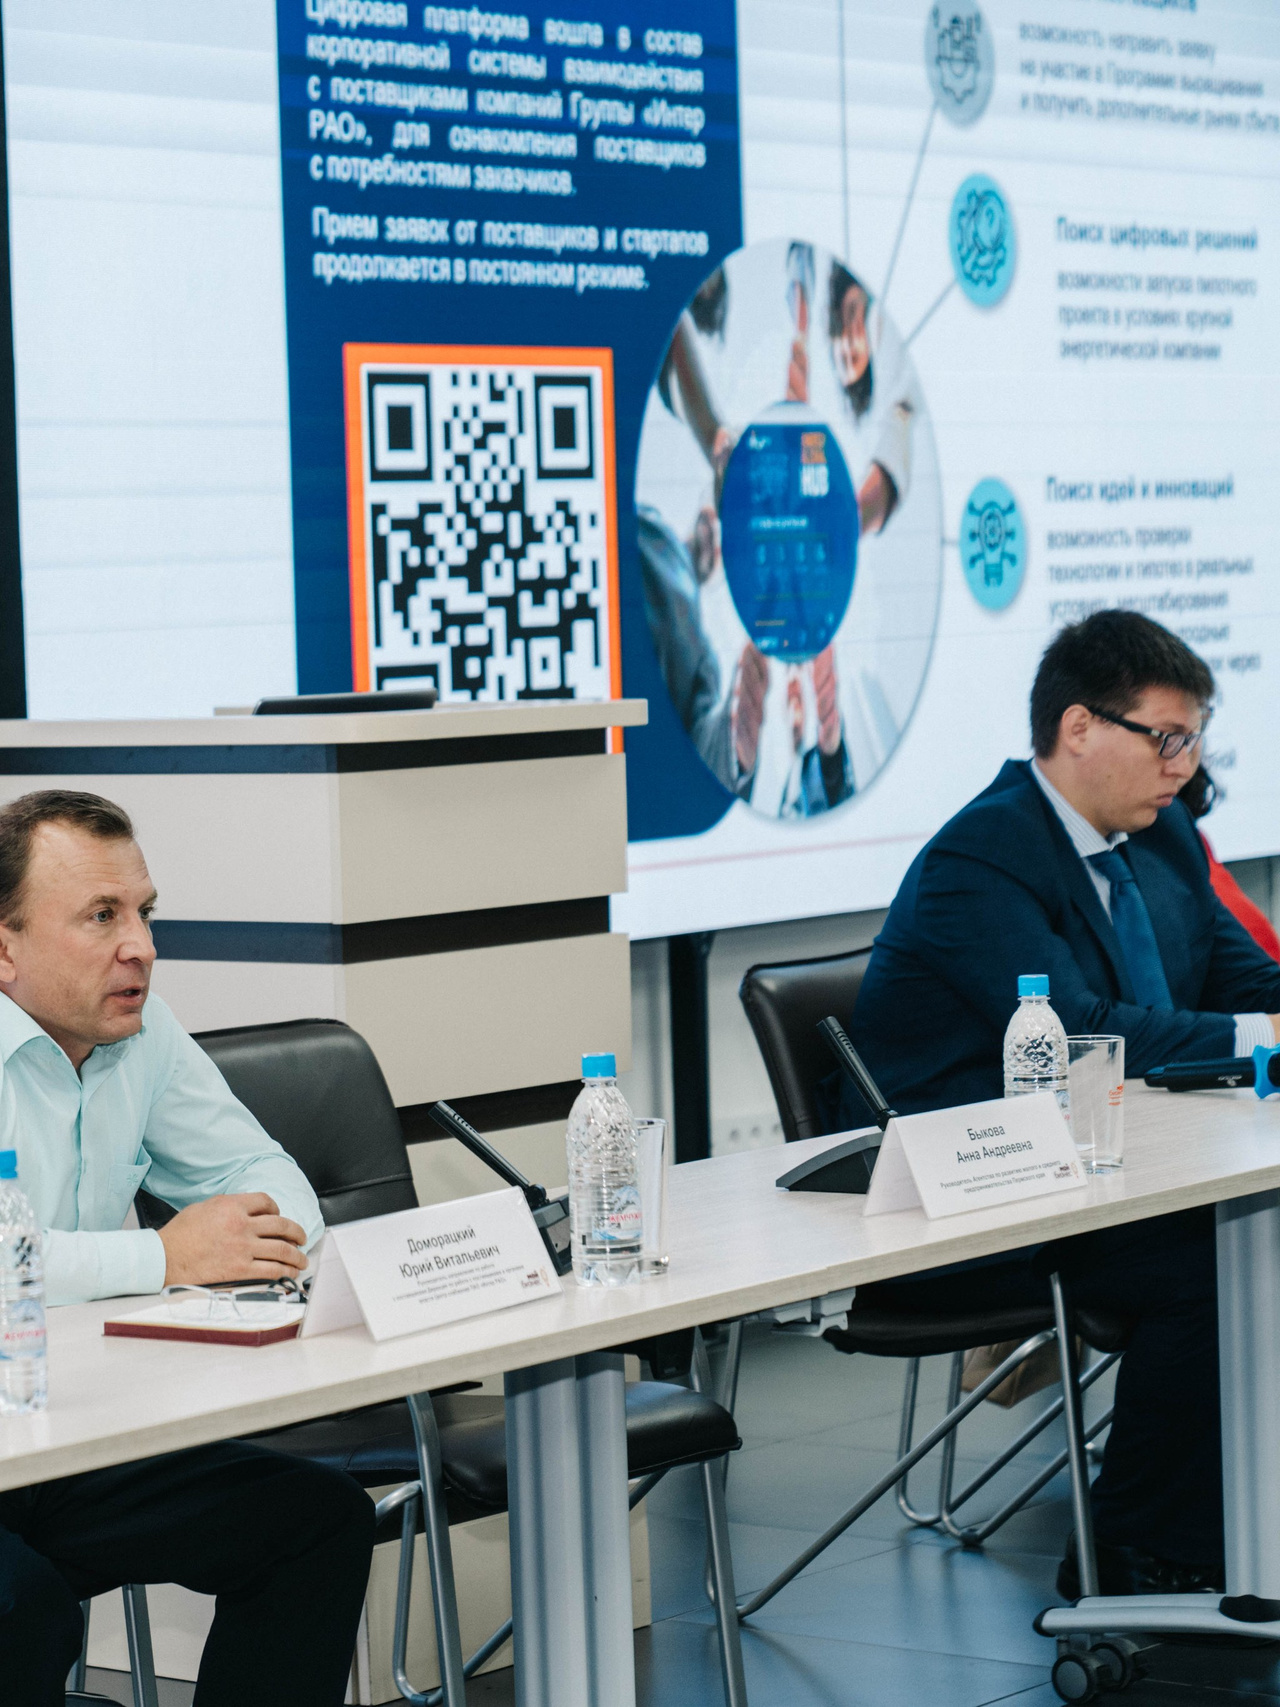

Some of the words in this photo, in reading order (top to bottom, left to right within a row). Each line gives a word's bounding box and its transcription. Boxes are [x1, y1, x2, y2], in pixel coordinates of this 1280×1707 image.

[305, 0, 408, 30] Цифровая
[424, 6, 529, 43] платформа
[544, 19, 604, 48] вошла
[617, 26, 631, 51] в
[644, 29, 703, 57] состав
[306, 34, 450, 71] корпоративной
[468, 51, 547, 80] системы
[564, 58, 704, 93] взаимодействия
[307, 75, 321, 101] с
[331, 76, 468, 115] поставщиками
[476, 89, 563, 119] компаний
[569, 92, 635, 130] Группы
[643, 99, 705, 136] «Интер
[309, 109, 373, 147] РАО»,
[392, 122, 430, 149] для
[449, 125, 577, 158] ознакомления
[595, 135, 706, 170] поставщиков
[310, 154, 323, 180] с
[327, 154, 471, 191] потребностями
[474, 166, 577, 195] заказчиков.
[313, 206, 378, 247] Прием
[385, 215, 449, 243] заявок
[454, 220, 477, 244] от
[484, 221, 599, 256] поставщиков
[604, 226, 617, 251] и
[622, 227, 709, 260] стартапов
[1057, 216, 1103, 243] Поиск
[1110, 222, 1189, 250] цифровых
[1196, 228, 1258, 254] решений
[313, 252, 451, 285] продолжается
[454, 258, 467, 283] в
[469, 259, 575, 287] постоянном
[577, 263, 649, 295] режиме.
[1047, 476, 1092, 501] Поиск
[1100, 476, 1134, 504] идей
[1142, 481, 1149, 498] и
[1156, 474, 1233, 503] инноваций
[956, 1151, 981, 1164] Анна
[982, 1139, 1033, 1158] Андреевна
[966, 1125, 1005, 1141] Быкова
[407, 1225, 476, 1255] Доморацкий
[399, 1257, 434, 1280] Юрий
[434, 1245, 501, 1271] Витальевич
